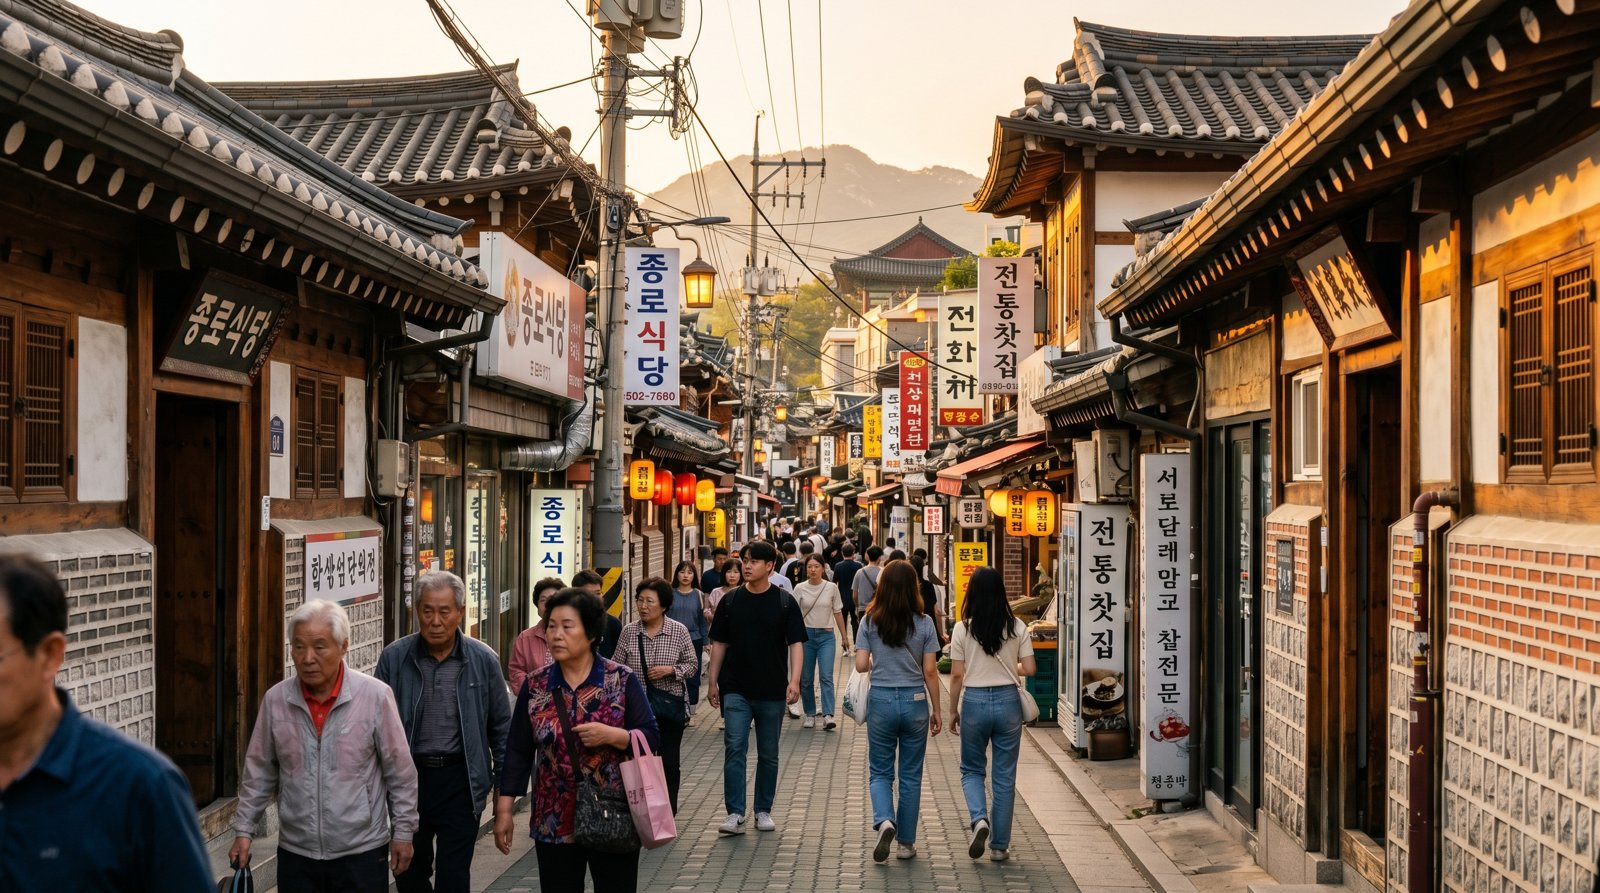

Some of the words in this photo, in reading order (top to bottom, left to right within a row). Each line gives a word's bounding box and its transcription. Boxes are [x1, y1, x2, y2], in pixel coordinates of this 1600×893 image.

[184, 292, 273, 358] 종로식당
[521, 277, 566, 359] 종로식당
[637, 253, 669, 387] 종로식당
[993, 262, 1021, 379] 전통찻집
[1088, 516, 1117, 660] 전통찻집
